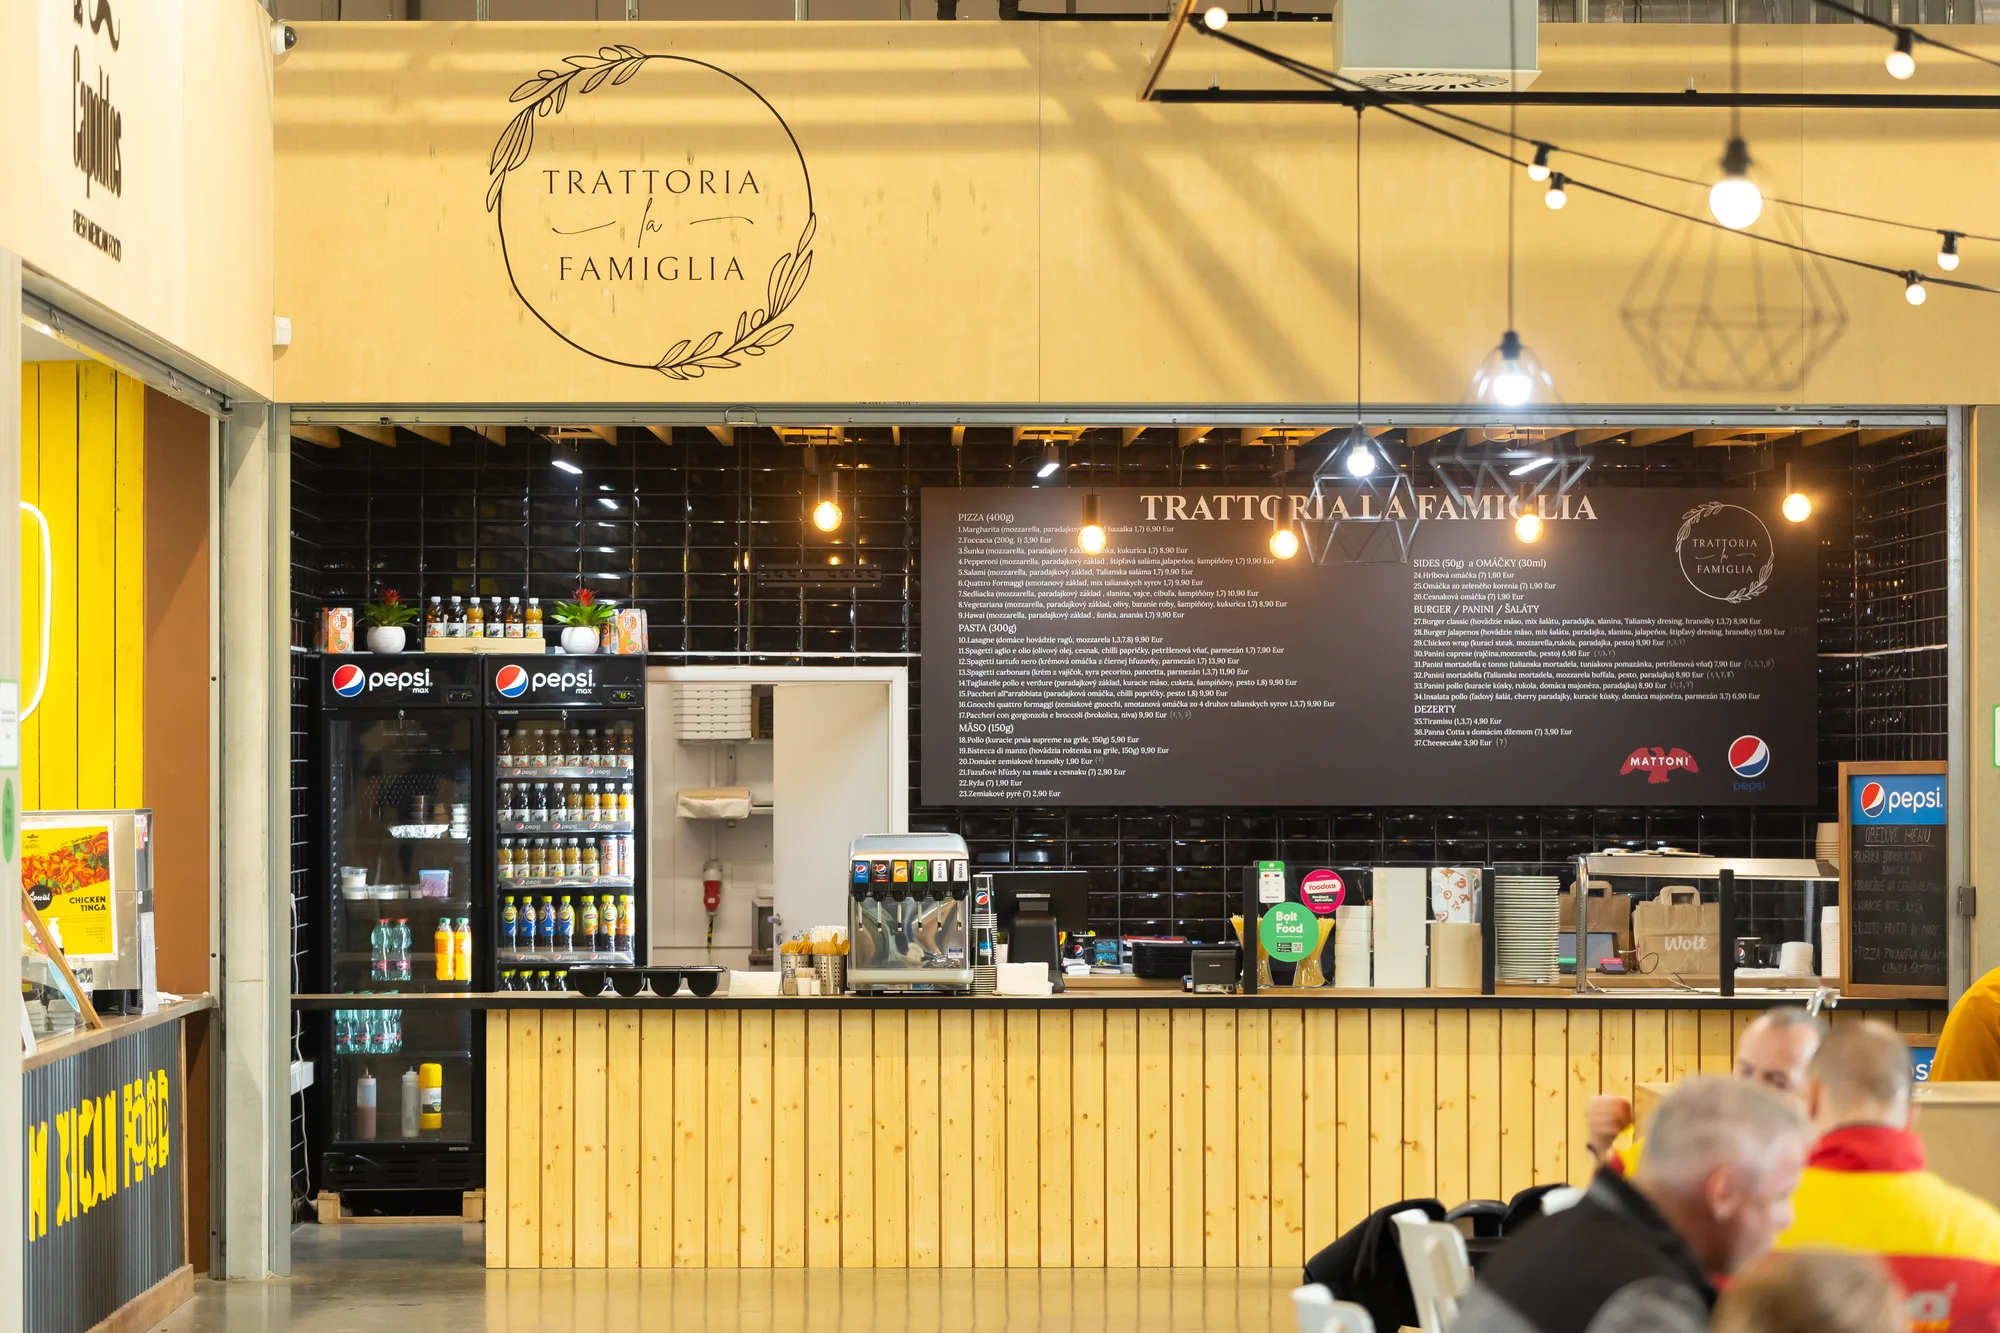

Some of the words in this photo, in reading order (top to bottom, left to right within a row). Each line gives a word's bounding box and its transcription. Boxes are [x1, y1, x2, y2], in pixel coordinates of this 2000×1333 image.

[542, 170, 760, 194] TRATTORIA
[638, 197, 663, 248] la
[560, 256, 745, 281] FAMIGLIA
[1359, 494, 1408, 520] LA
[986, 513, 1014, 523] (400g)
[1017, 536, 1023, 546] 1)
[1692, 538, 1758, 548] TRATTORIA
[1414, 559, 1440, 568] SIDES
[1442, 558, 1464, 569] (50g)
[1476, 557, 1516, 568] OMÁČKY
[1518, 558, 1546, 569] (30ml)
[987, 568, 1028, 578] (mozzarella,
[1029, 568, 1069, 578] paradajkový
[1164, 568, 1180, 577] 9,90
[1697, 564, 1753, 574] FAMIGLIA
[1478, 571, 1487, 580] (7)
[1519, 582, 1528, 591] (7)
[1413, 592, 1459, 600] 26.Cesnaková
[1460, 592, 1486, 600] omáčka
[1487, 593, 1496, 602] (7)
[1414, 605, 1451, 613] BURGER
[1453, 605, 1460, 615] /
[1462, 605, 1494, 613] PANINI
[1496, 605, 1503, 615] /
[1505, 603, 1539, 613] ŠALÁTY
[958, 624, 987, 632] PASTA
[988, 624, 1017, 634] (300g)
[958, 636, 995, 645] 10.Lasagne
[996, 636, 1024, 645] (domáce
[1134, 636, 1149, 644] 9,90
[1540, 650, 1561, 659] pesto)
[1562, 650, 1577, 658] 6,90
[369, 668, 430, 691] pepsi
[532, 669, 593, 692] pepsi
[1414, 705, 1456, 713] DEZERTY
[1473, 717, 1488, 726] 4,90
[988, 724, 1014, 734] (150g)
[1472, 728, 1503, 736] domácim
[1504, 728, 1533, 736] džemom
[1534, 728, 1543, 737] (7)
[1544, 728, 1559, 736] 3,90
[985, 736, 1013, 745] (kuracie
[1014, 736, 1031, 745] prsia
[1073, 736, 1090, 745] grile,
[1092, 736, 1110, 745] 150g)
[1111, 736, 1125, 744] 5,90
[1463, 739, 1478, 748] 3,90
[1630, 756, 1689, 766] MATTONI
[959, 778, 984, 788] 22.Ryža
[985, 779, 994, 788] (7)
[1733, 781, 1765, 792] pepsi
[1006, 789, 1022, 799] pyré
[1022, 790, 1031, 799] (7)
[1032, 790, 1047, 798] 2,90
[1889, 787, 1940, 813] pepsi
[1904, 828, 1932, 843] MENU
[69, 896, 106, 904] CHICKEN
[1276, 911, 1297, 921] Bolt
[1276, 924, 1303, 933] Food
[1664, 935, 1707, 951] Wolt
[124, 1070, 169, 1188] FOOD
